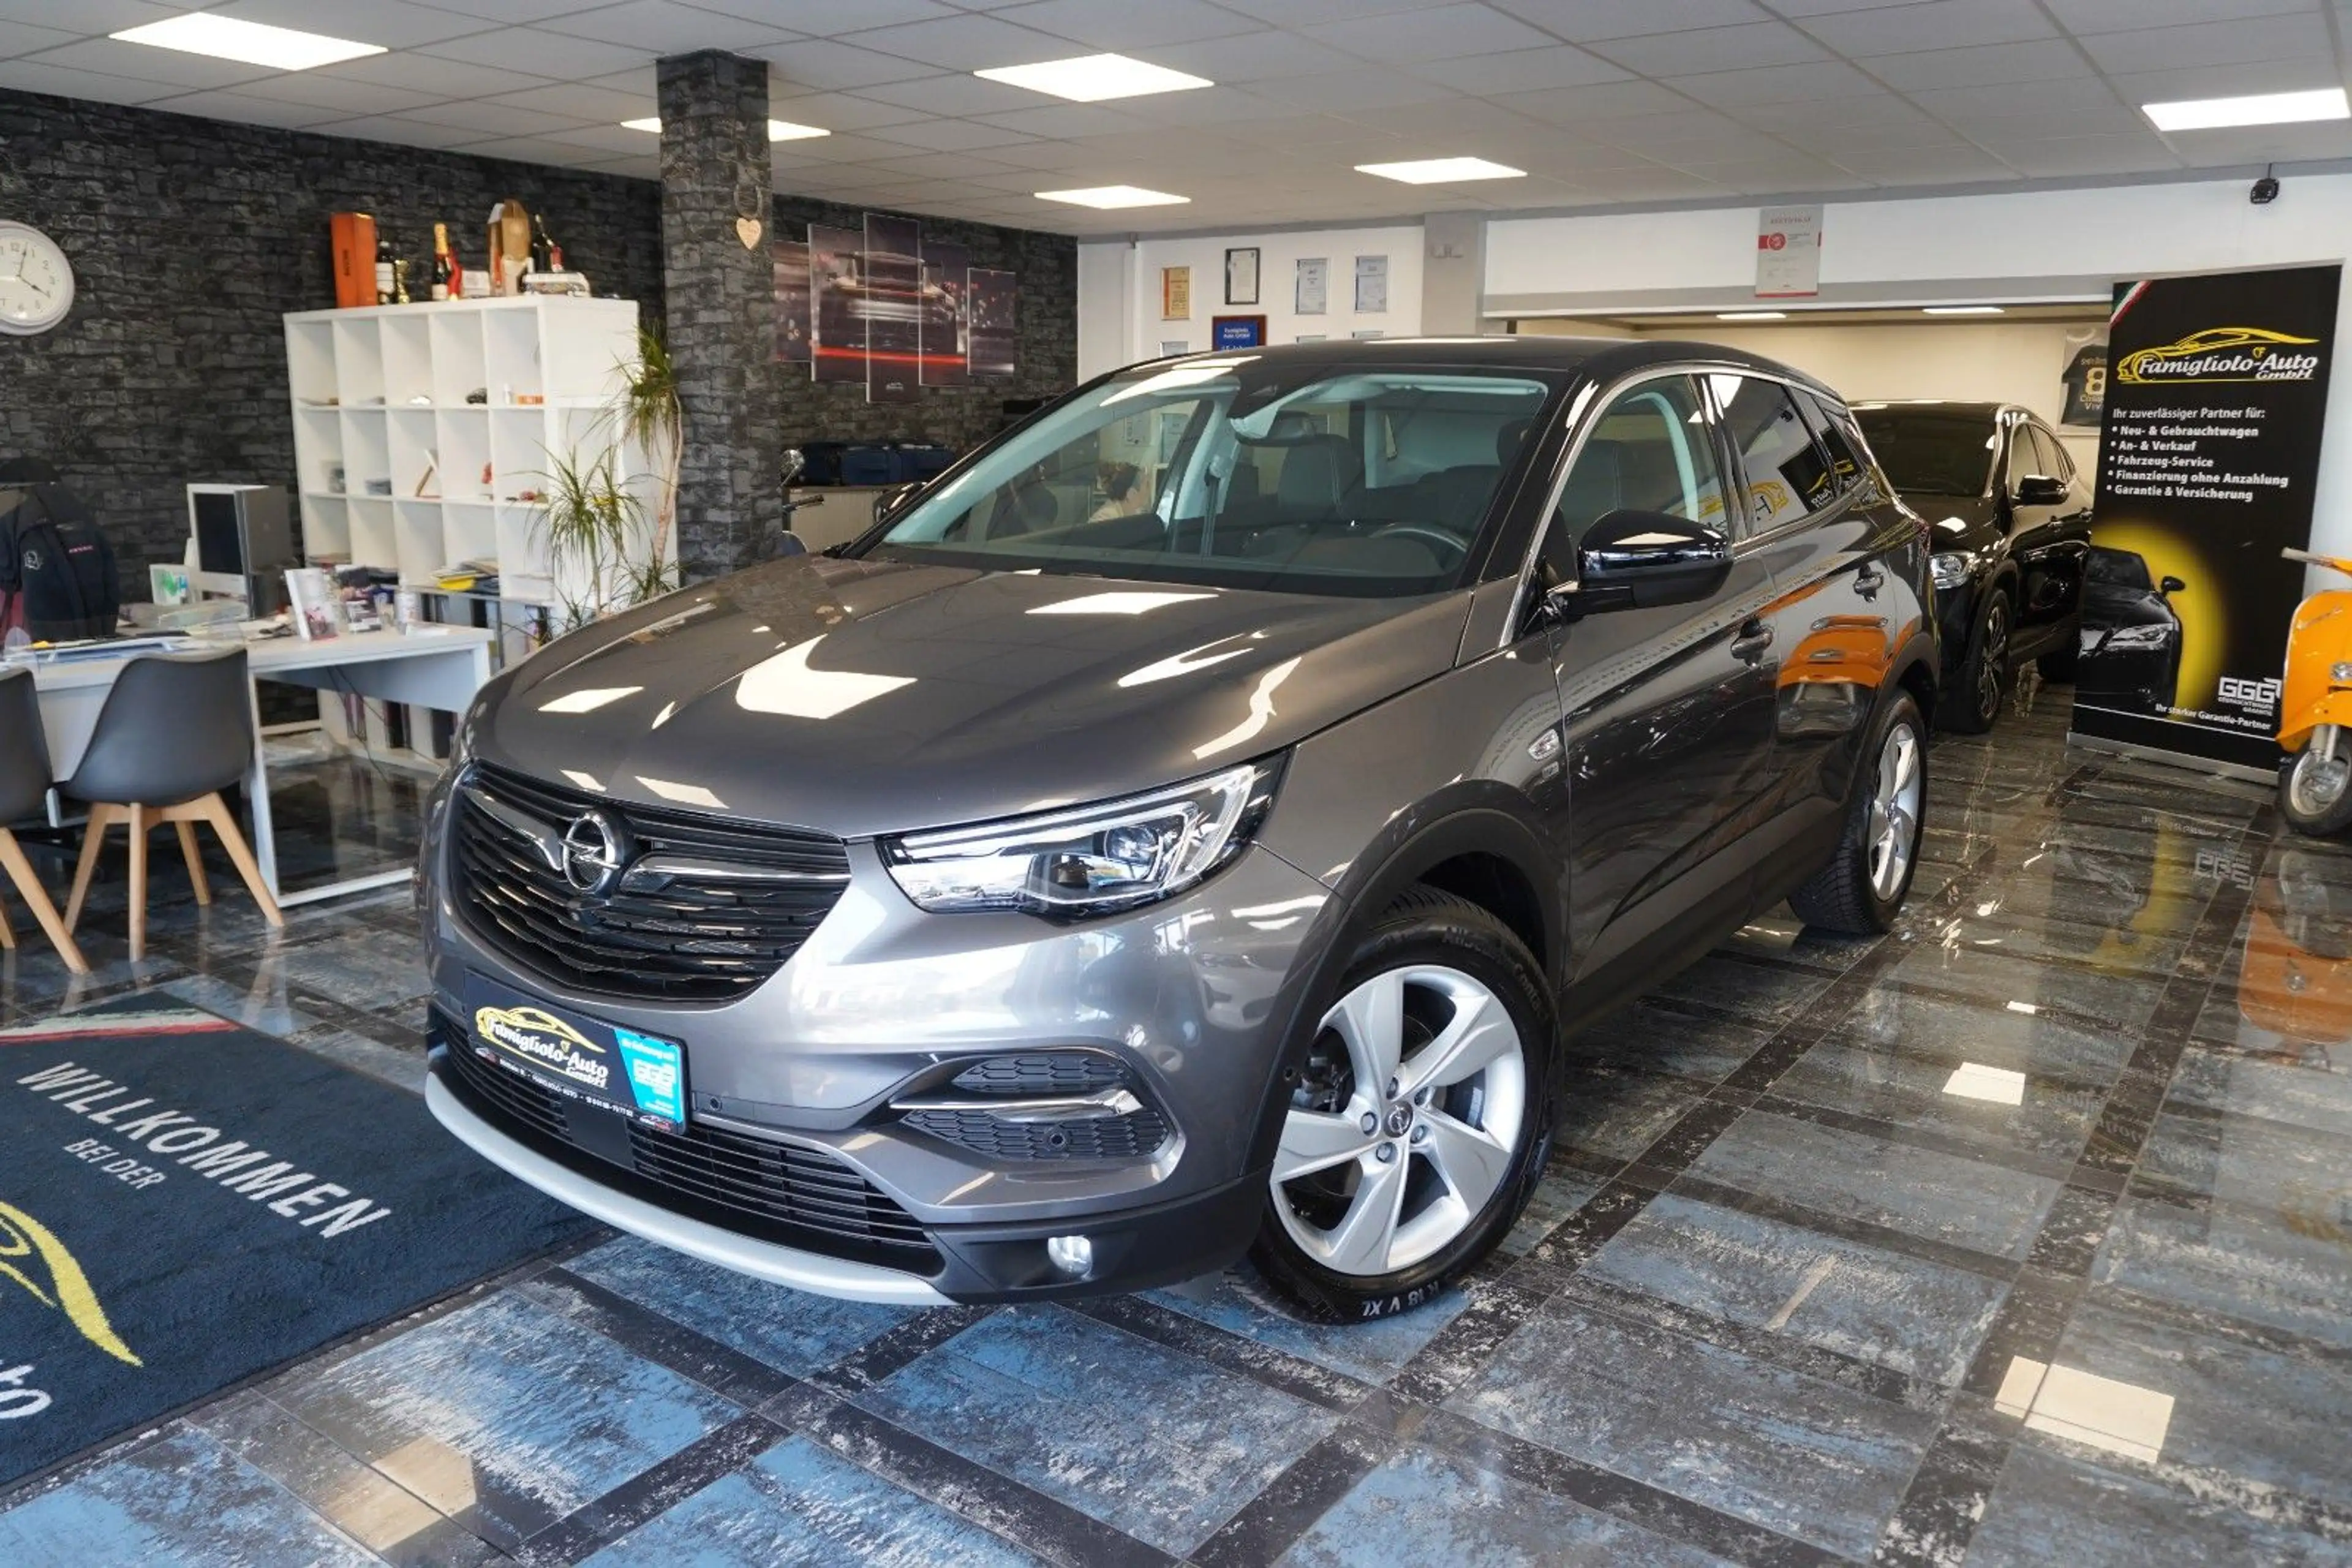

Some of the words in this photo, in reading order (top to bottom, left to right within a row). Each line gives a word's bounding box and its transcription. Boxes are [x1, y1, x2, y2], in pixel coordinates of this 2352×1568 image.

[2139, 353, 2318, 376] Famigliolo-Auto
[2255, 369, 2313, 380] GmbH
[2113, 409, 2127, 418] Ihr
[2129, 408, 2198, 421] zuverlässiger
[2200, 407, 2243, 418] Partner
[2245, 407, 2265, 418] für:
[2120, 426, 2146, 436] Neu-
[2148, 426, 2158, 436] &
[2160, 425, 2259, 439] Gebrauchtwagen
[2118, 441, 2138, 450] An-
[2140, 441, 2149, 451] &
[2152, 441, 2197, 452] Verkauf
[2117, 455, 2214, 468] Fahrzeug-Service
[2116, 470, 2188, 484] Finanzierung
[2190, 472, 2220, 483] ohne
[2223, 473, 2289, 488] Anzahlung
[2115, 484, 2162, 497] Garantie
[2164, 486, 2173, 497] &
[2176, 486, 2253, 502] Versicherung
[2218, 676, 2282, 704] GGG
[2198, 711, 2271, 731] Garantie-Partner
[17, 1061, 392, 1240] WILLKOMMEN
[62, 1137, 120, 1164] BEI
[101, 1158, 167, 1190] DER
